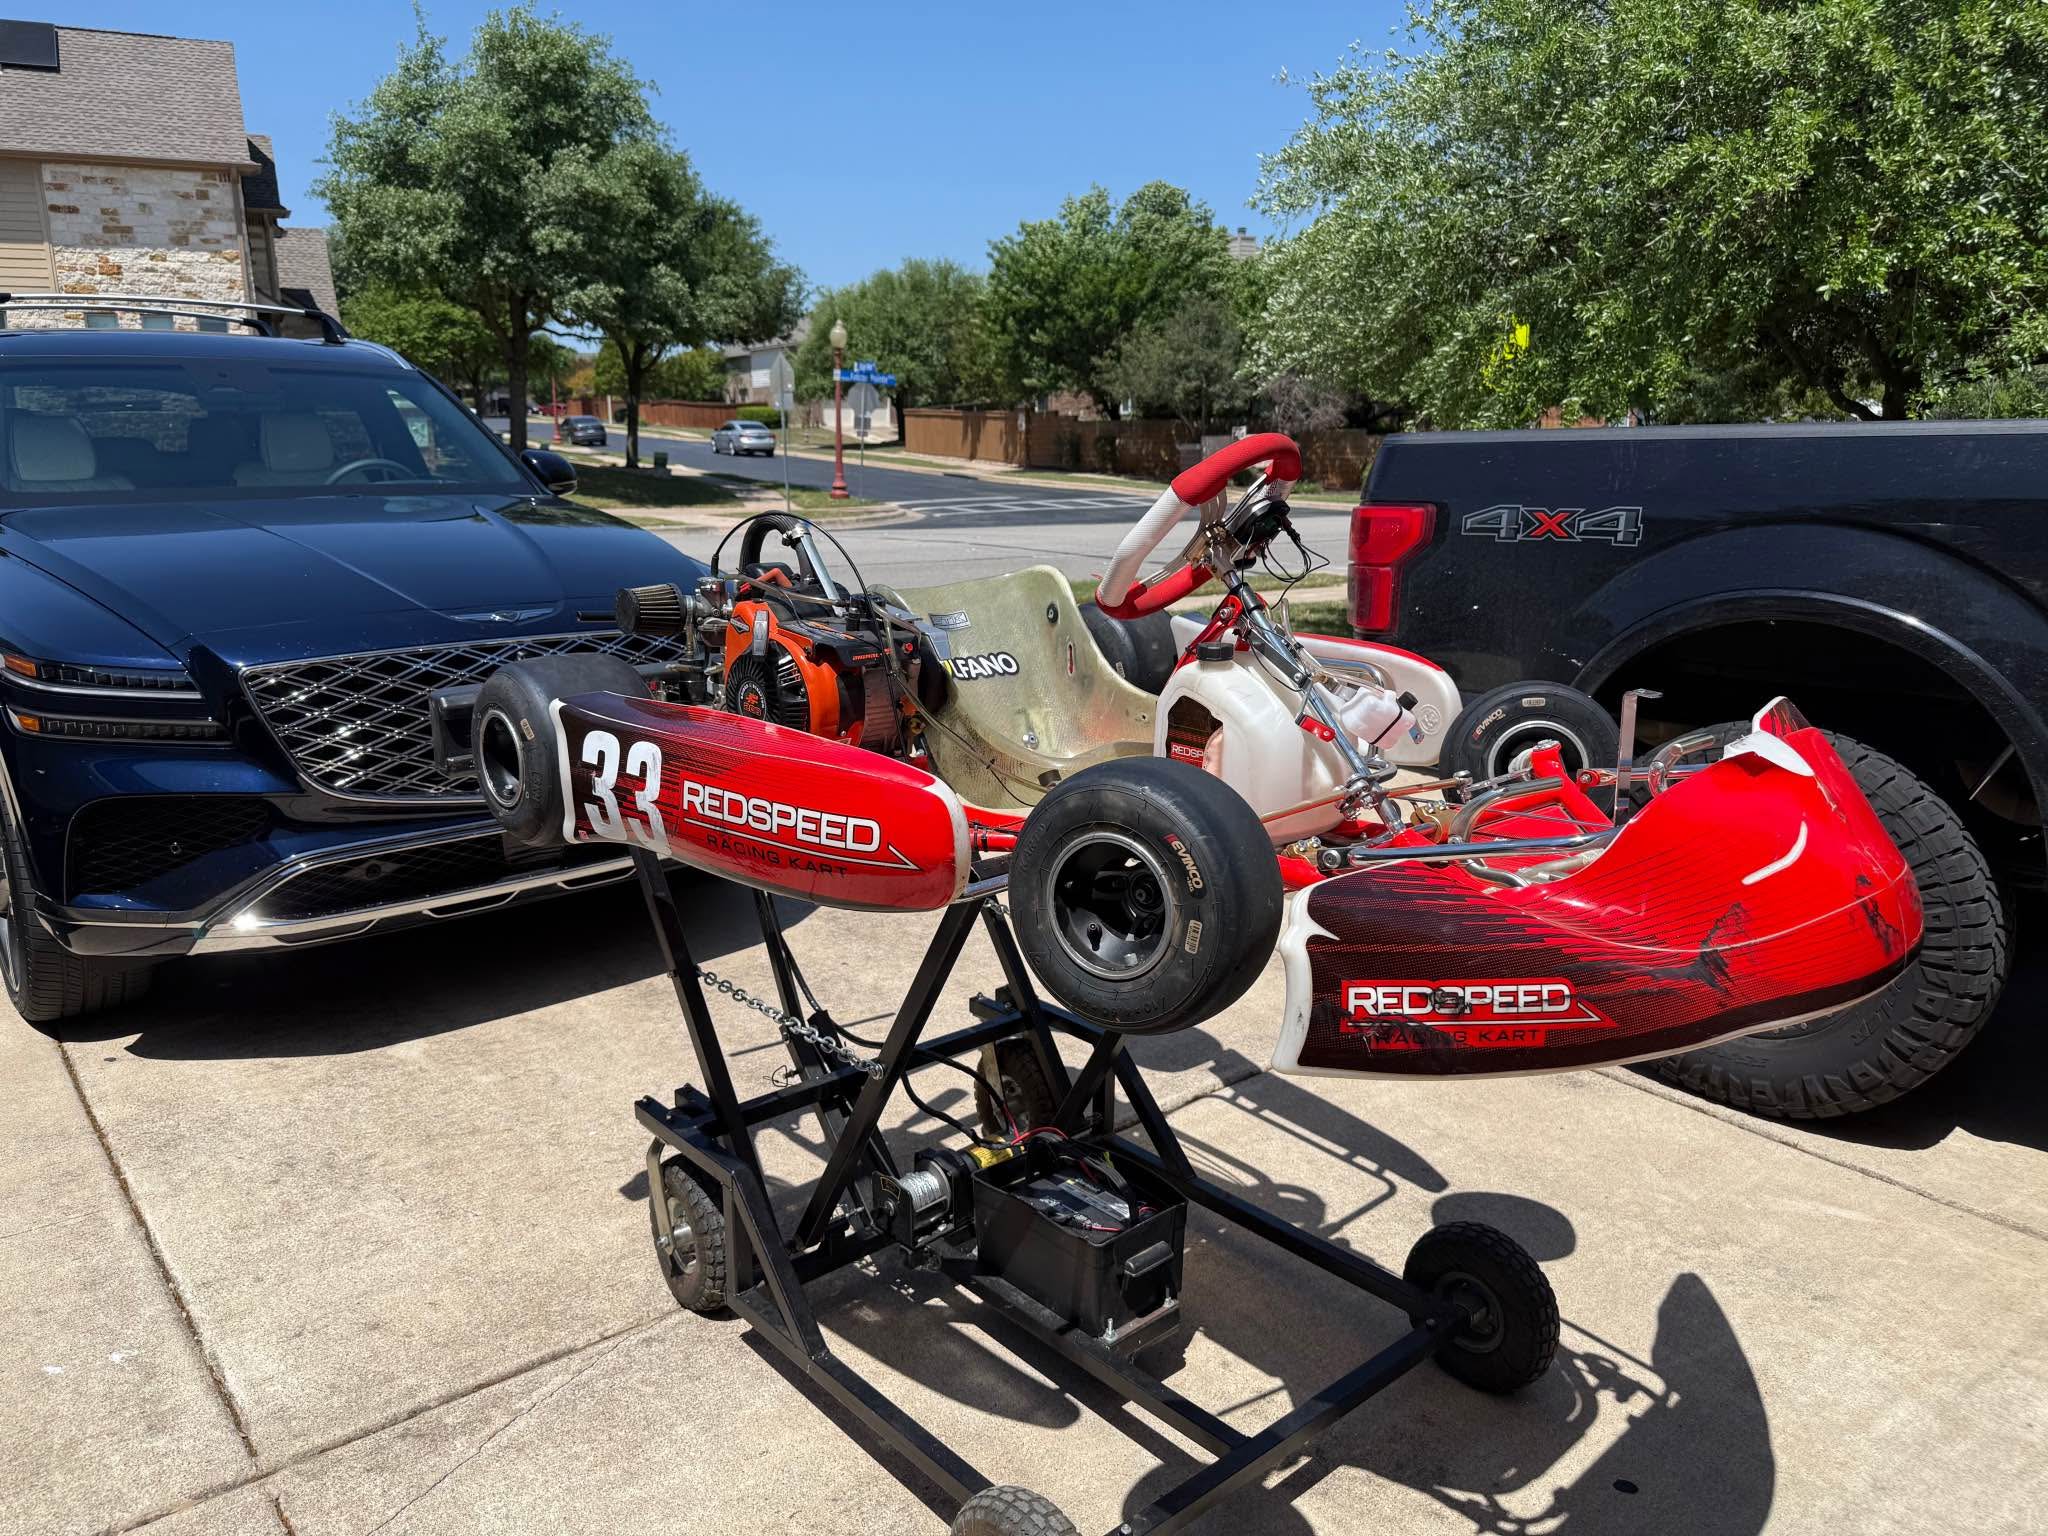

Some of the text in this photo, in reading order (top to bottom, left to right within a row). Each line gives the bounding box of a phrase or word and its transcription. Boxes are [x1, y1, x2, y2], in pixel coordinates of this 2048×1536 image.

[944, 652, 1019, 680] LFANO
[1475, 708, 1503, 735] EVINCO
[1172, 744, 1204, 758] REDSP
[581, 730, 672, 856] 33
[682, 780, 881, 853] REDSPEED
[707, 834, 849, 879] RACING KART
[1171, 840, 1204, 890] EVINCO
[1347, 983, 1571, 1016] REDSPEED
[1378, 1028, 1542, 1045] RACG KART
